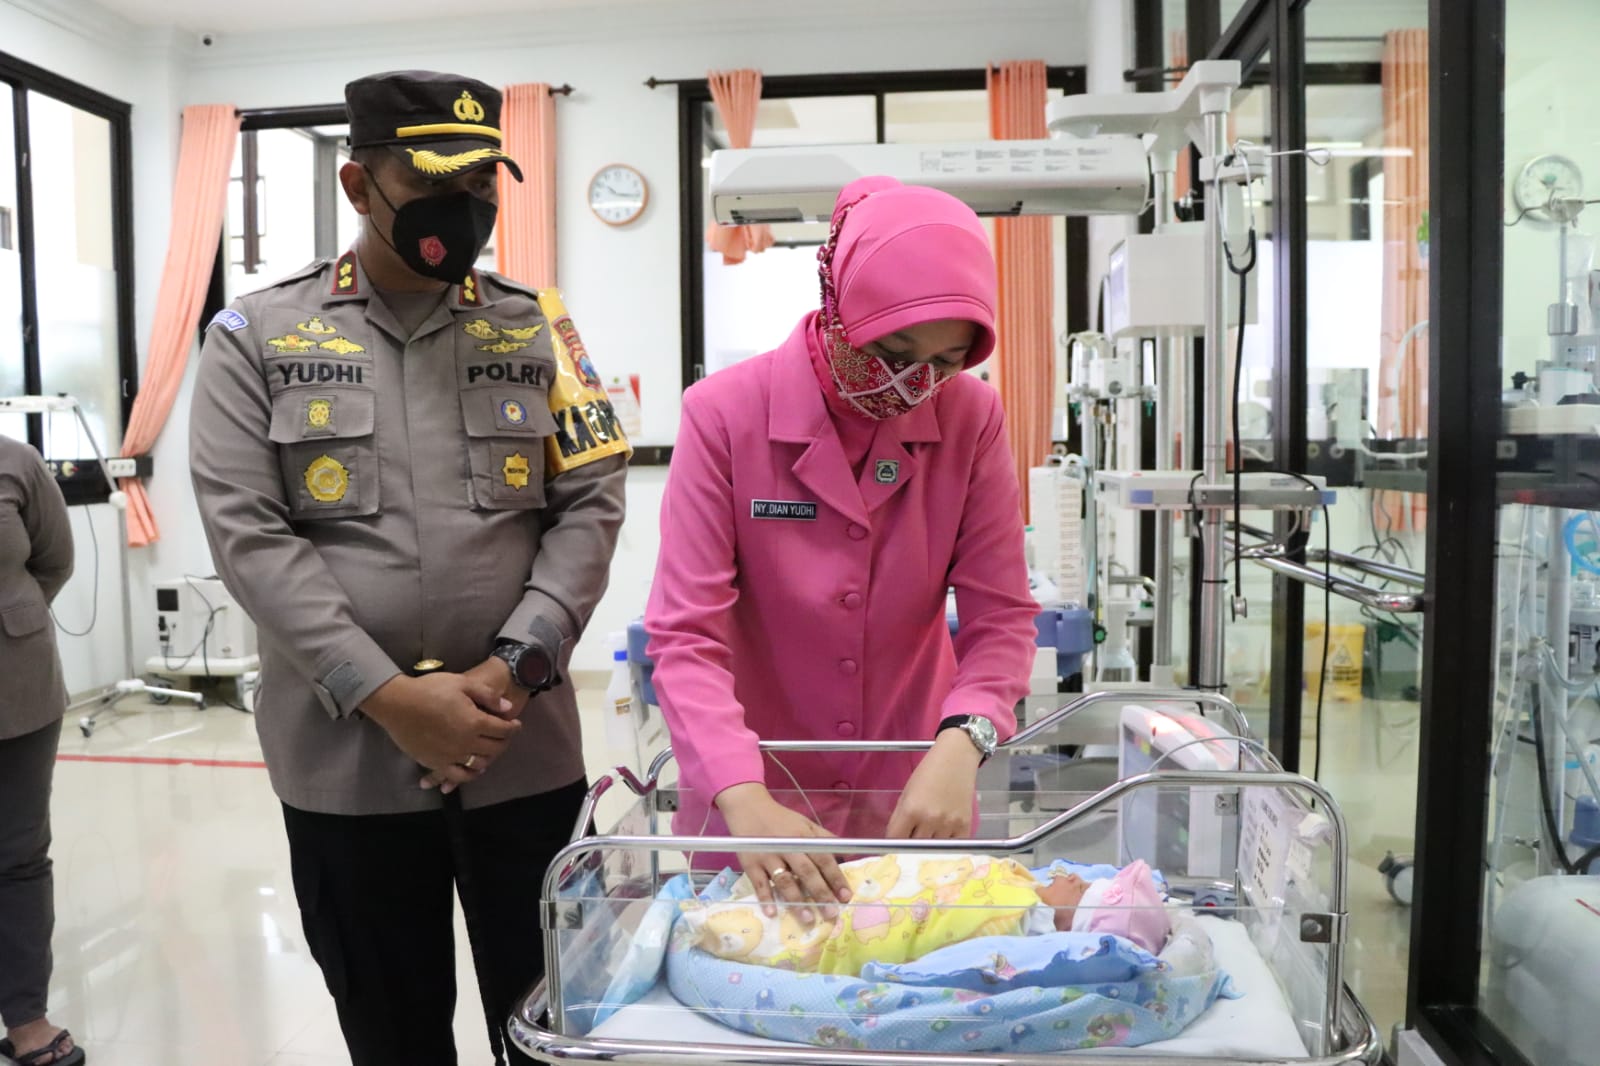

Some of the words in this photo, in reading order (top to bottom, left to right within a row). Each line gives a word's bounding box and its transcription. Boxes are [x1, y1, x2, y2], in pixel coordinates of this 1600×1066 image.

[276, 362, 363, 385] YUDHI
[467, 362, 542, 386] POLRI
[789, 505, 815, 516] YUDHI
